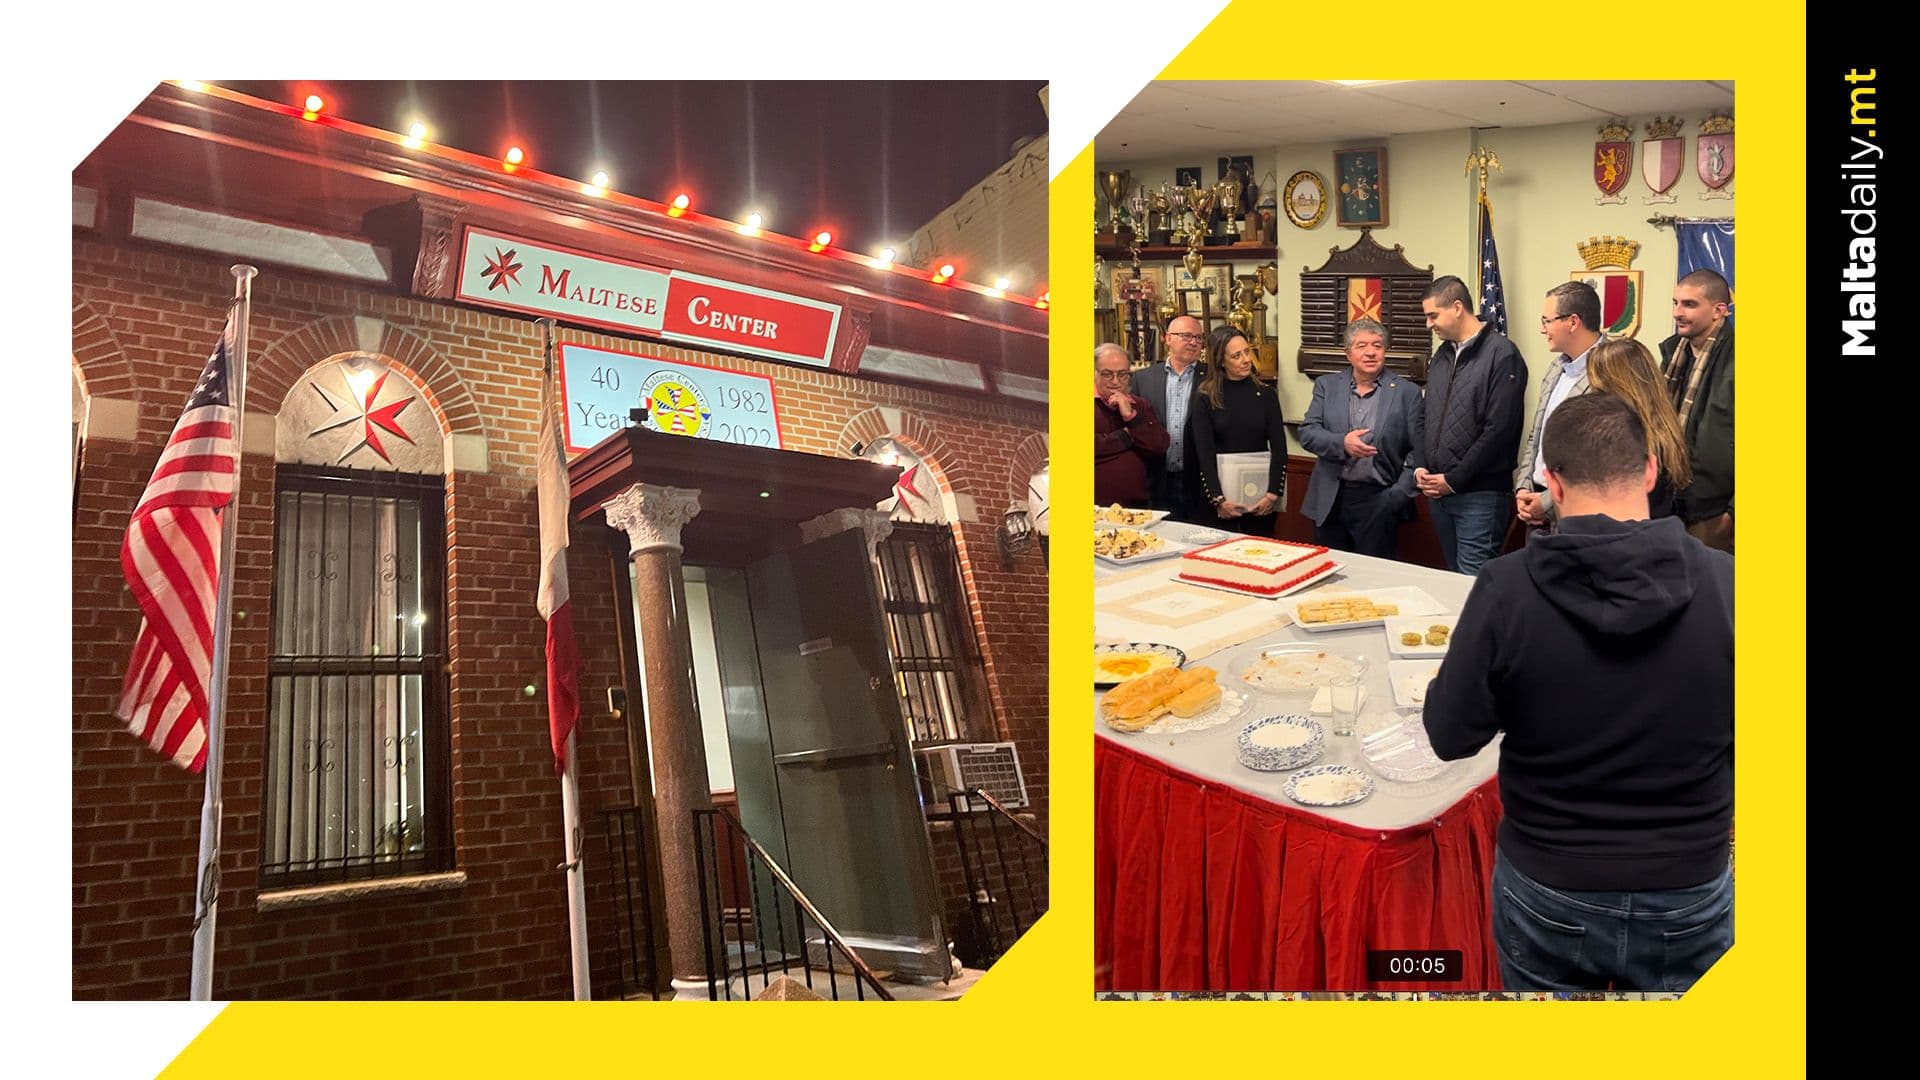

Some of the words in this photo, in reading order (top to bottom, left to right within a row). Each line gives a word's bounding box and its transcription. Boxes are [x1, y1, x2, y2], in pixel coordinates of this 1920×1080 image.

[538, 264, 657, 316] MALTESE
[688, 296, 778, 339] CENTER
[590, 366, 620, 391] 40
[642, 373, 675, 394] Maltese
[717, 386, 768, 414] 1982
[574, 401, 631, 430] Year
